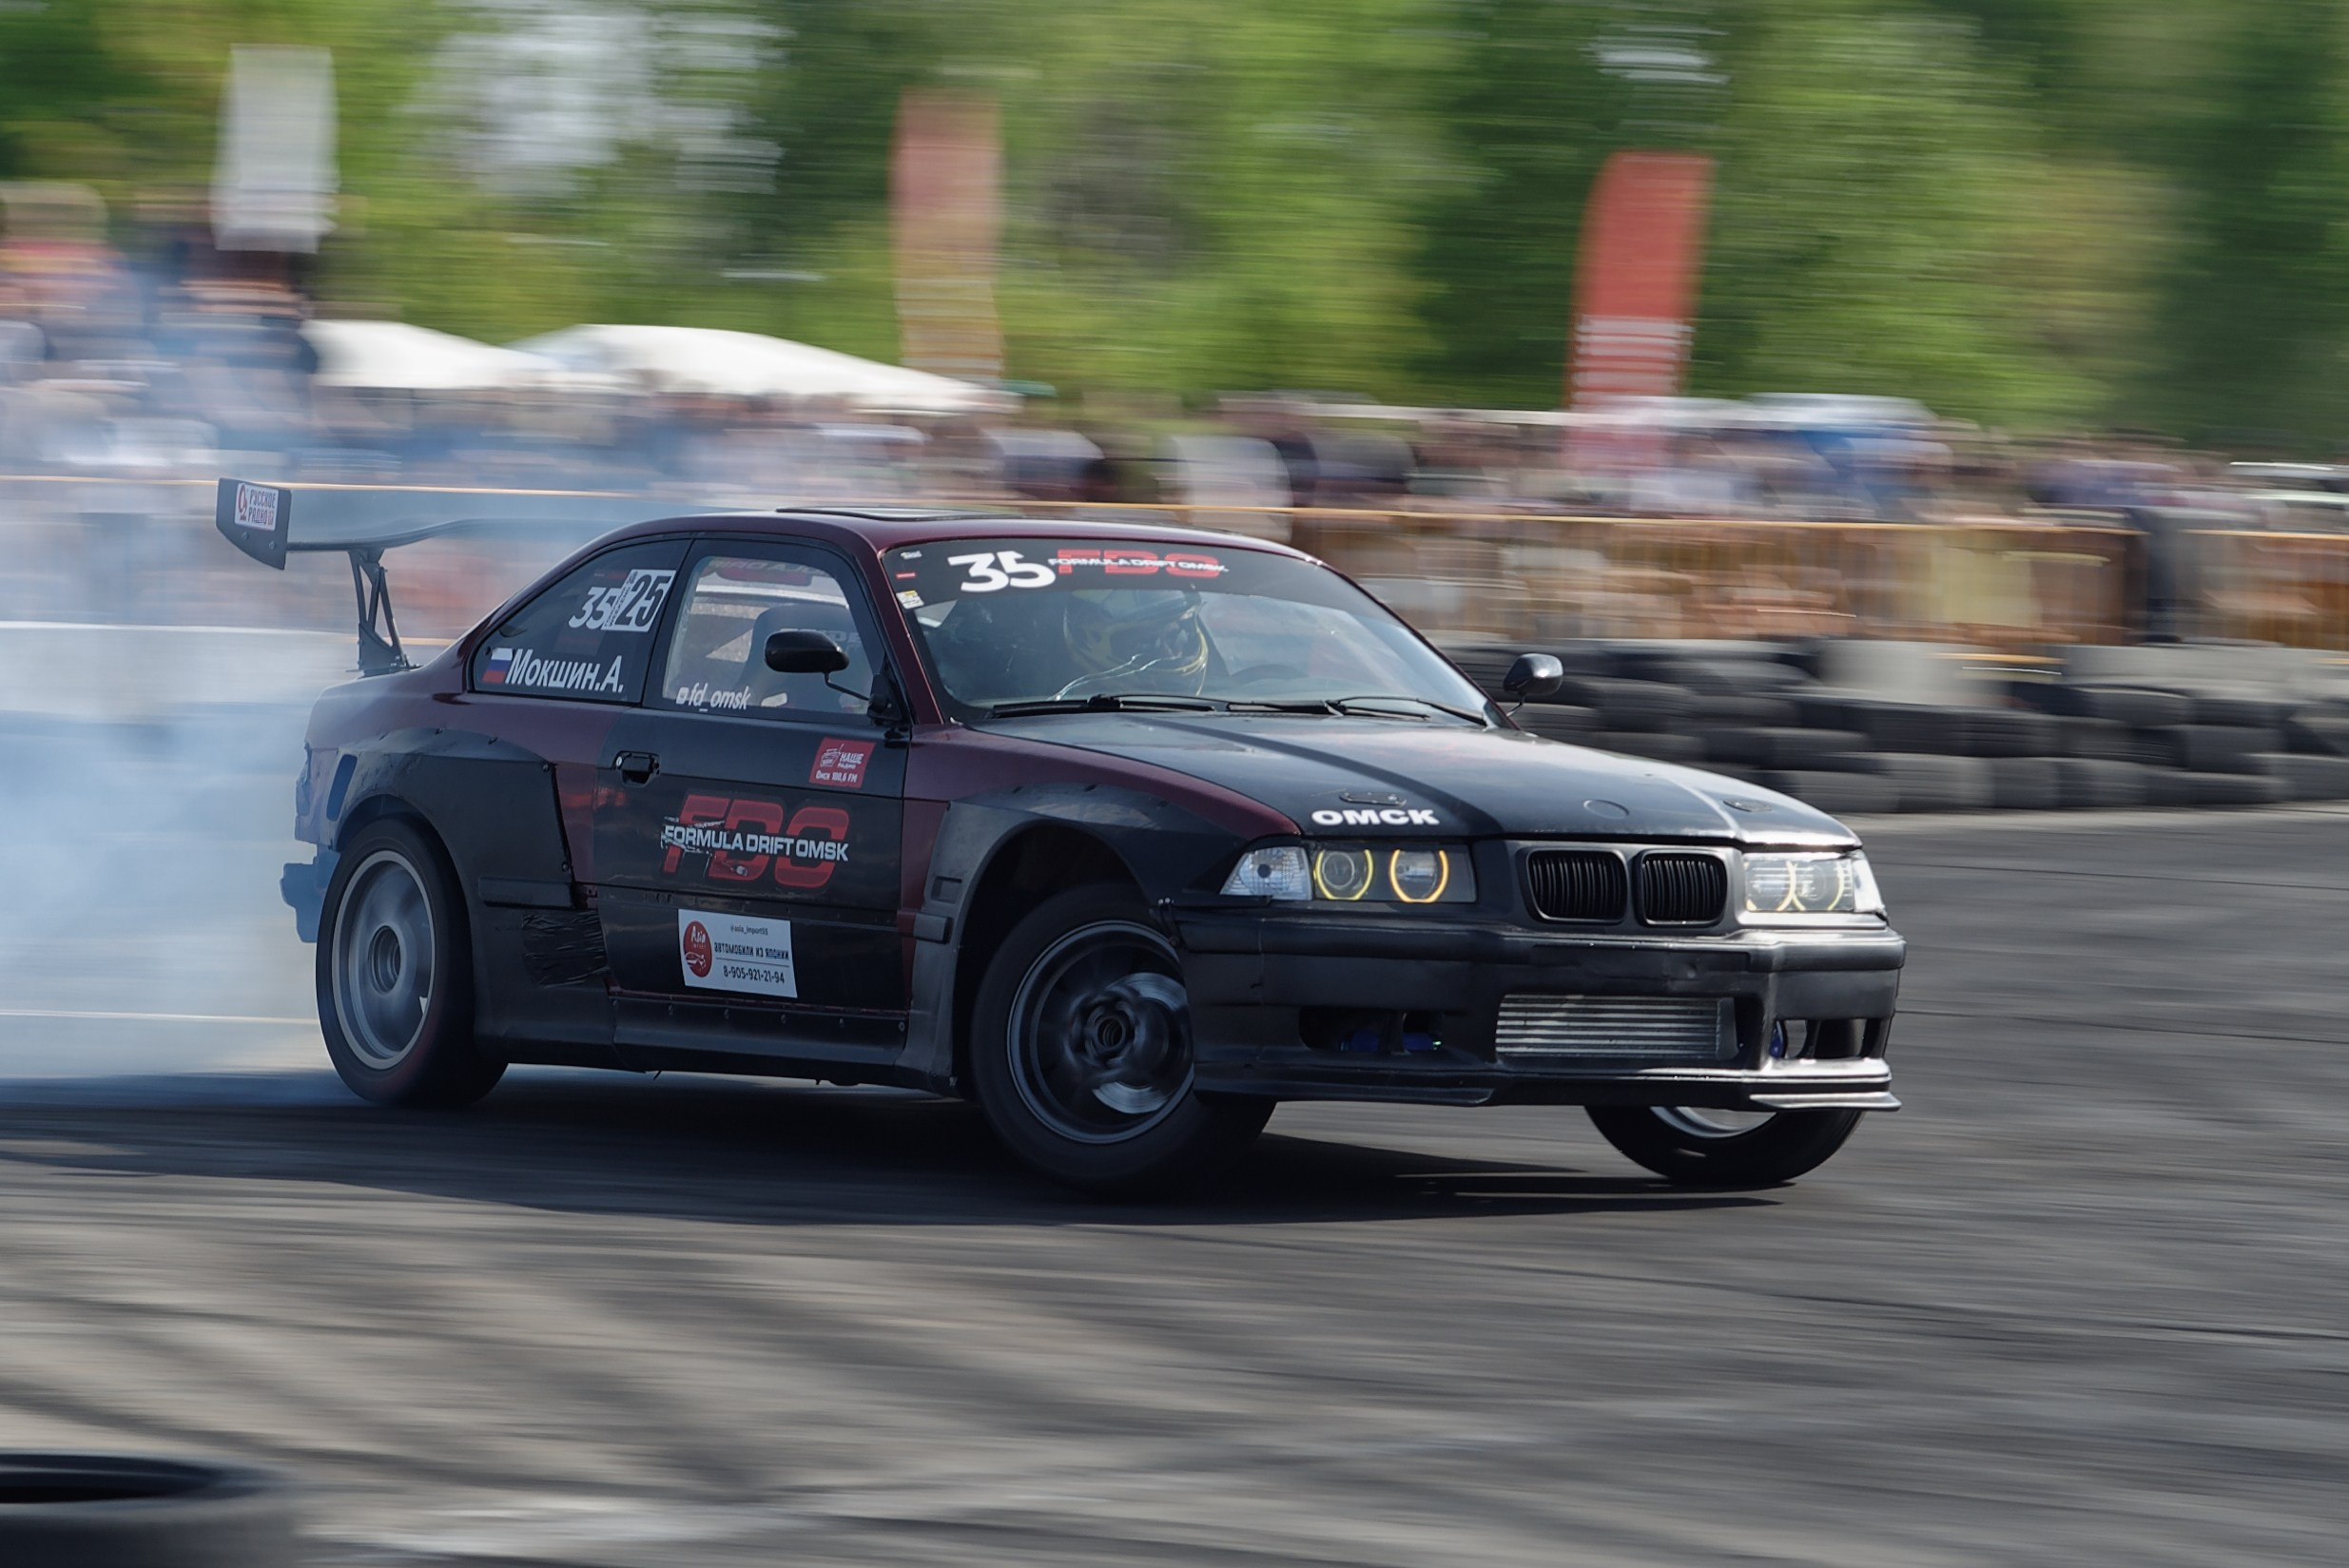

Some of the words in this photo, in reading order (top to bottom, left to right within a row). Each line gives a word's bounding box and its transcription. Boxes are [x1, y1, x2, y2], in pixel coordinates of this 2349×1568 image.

[947, 551, 1057, 592] 35
[1047, 558, 1132, 567] FORMULA
[1129, 558, 1175, 568] DRIFT
[569, 586, 625, 629] 35
[613, 573, 672, 628] 25
[1311, 809, 1441, 825] ОМСК
[663, 794, 849, 888] FDO
[663, 824, 744, 853] FORMULA
[746, 834, 794, 856] DRIFT
[795, 840, 849, 861] OMSK
[714, 941, 754, 957] АВТОМОБИЛИ
[756, 946, 764, 958] ИЗ
[723, 964, 785, 984] 8-905-921-21-94
